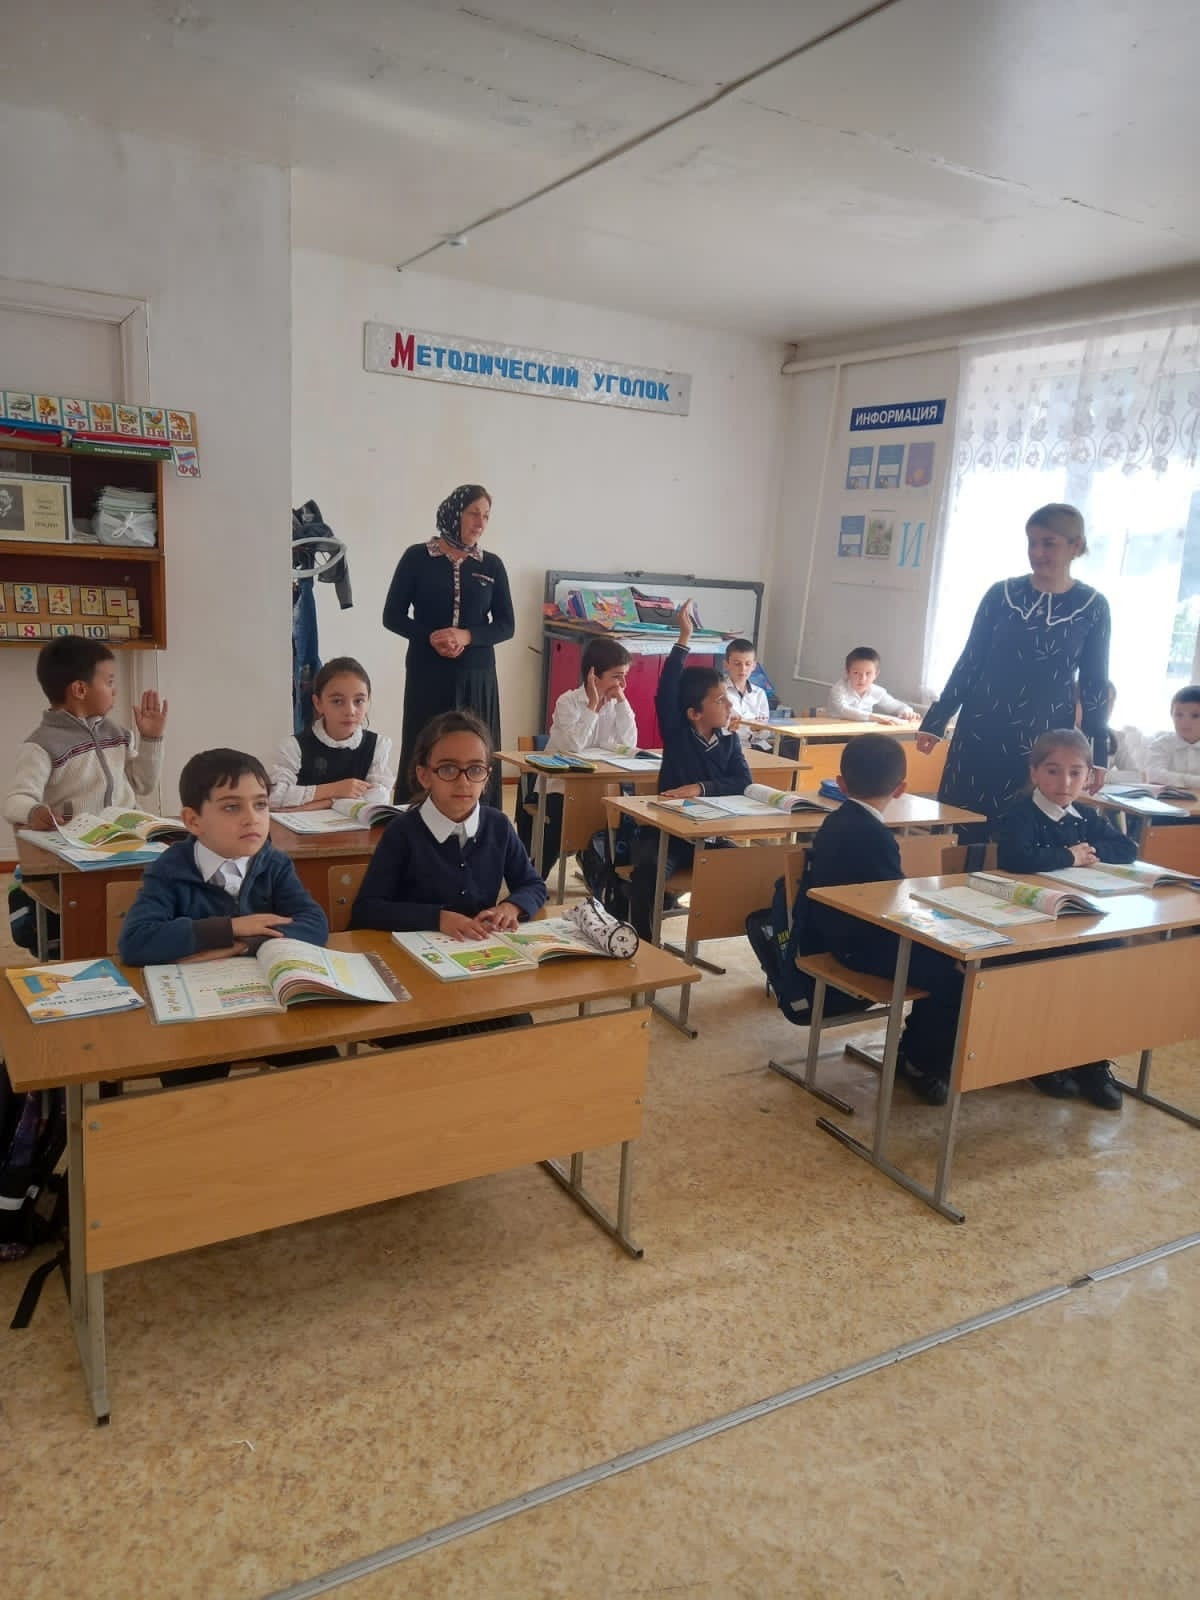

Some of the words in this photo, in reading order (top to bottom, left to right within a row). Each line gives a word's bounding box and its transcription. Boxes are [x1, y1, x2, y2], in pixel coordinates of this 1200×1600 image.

[390, 332, 579, 388] МЕТОДИЧЕСКИЙ
[593, 372, 670, 402] УГОЛОК
[855, 406, 938, 426] ИНФОРМАЦИЯ
[20, 586, 33, 601] 3
[53, 588, 65, 602] 4
[87, 589, 97, 603] 5
[23, 625, 36, 637] 8
[87, 626, 104, 638] 10
